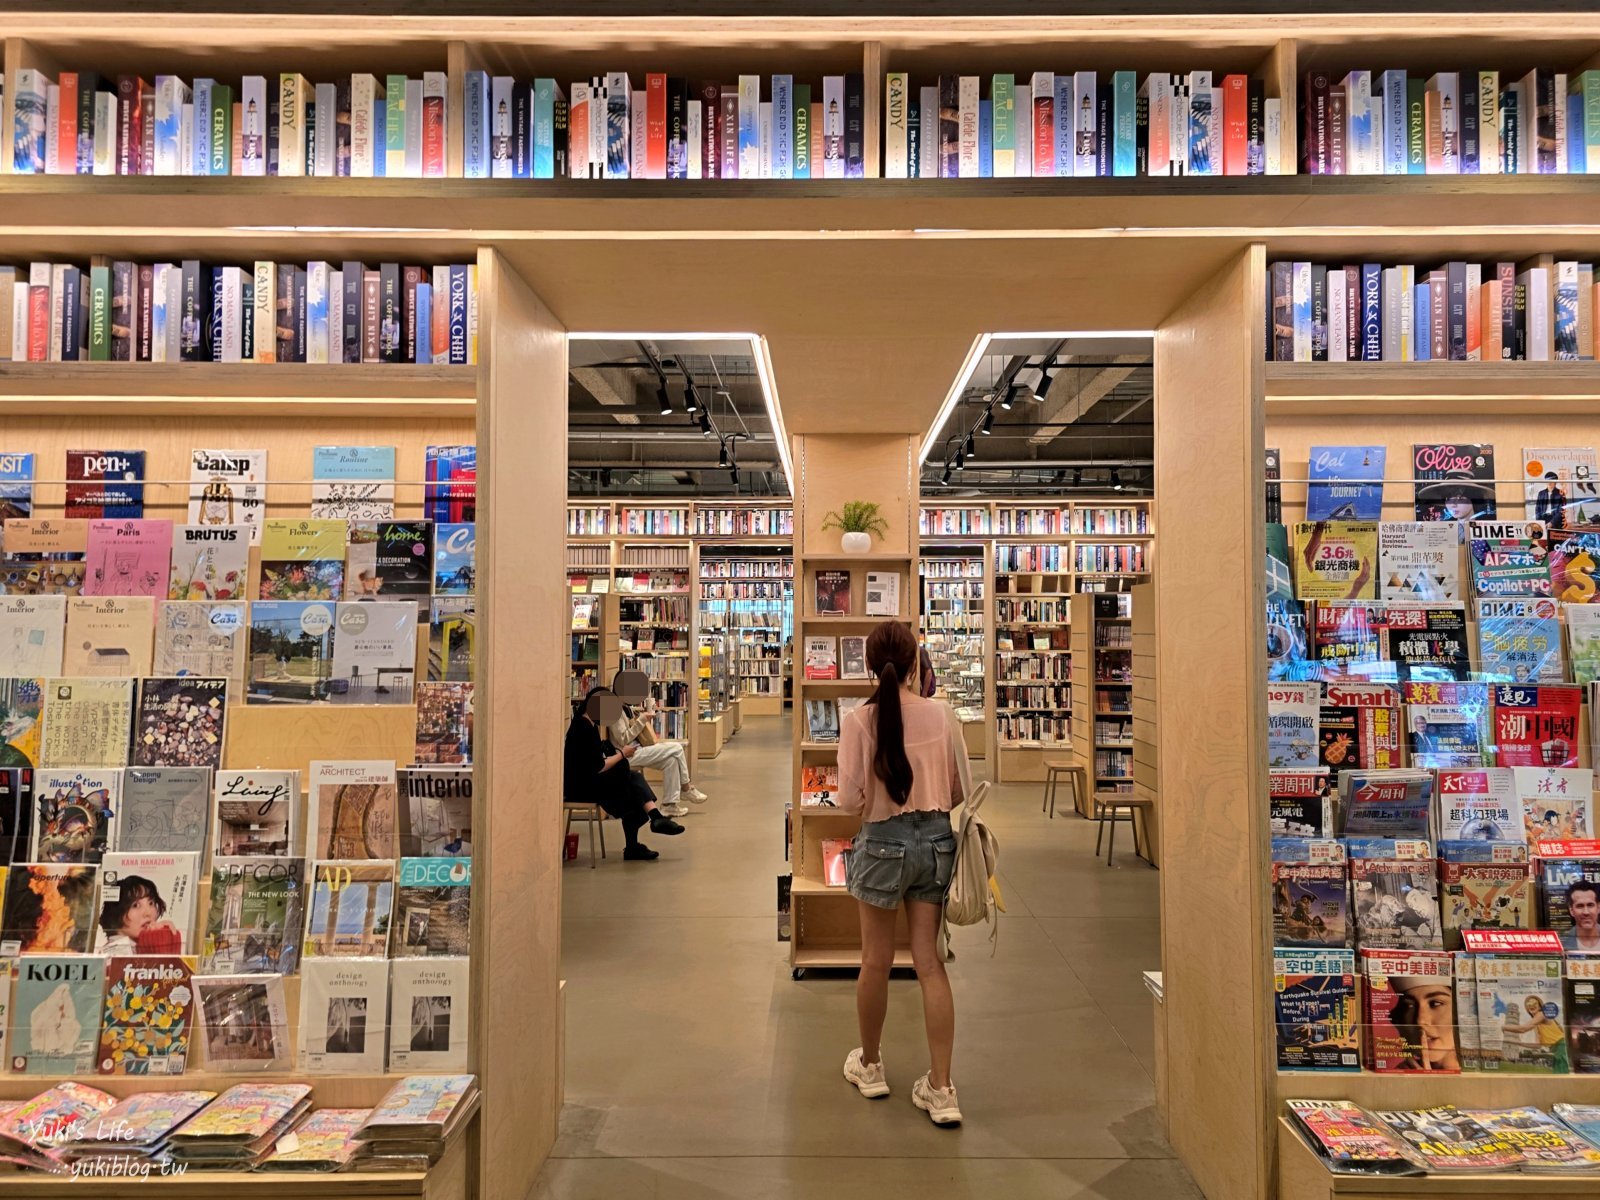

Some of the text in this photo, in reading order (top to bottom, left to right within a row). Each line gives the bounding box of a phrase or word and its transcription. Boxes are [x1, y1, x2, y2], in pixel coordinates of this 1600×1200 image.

[282, 77, 296, 130] CANDY
[890, 77, 904, 129] CANDY
[1481, 76, 1496, 127] CANDY
[387, 82, 399, 143] PEACHES
[995, 82, 1007, 143] PEACHES
[213, 107, 225, 170] CERAMICS
[726, 114, 734, 165] XIN LIFE
[796, 107, 807, 169] CERAMICS
[1333, 113, 1341, 163] XIN LIFE
[1411, 102, 1422, 164] CERAMICS
[256, 265, 270, 314] CANDY
[451, 272, 464, 308] YORK
[1314, 281, 1322, 296] THE
[1366, 271, 1379, 310] YORK
[1501, 266, 1513, 326] SUNSET
[93, 288, 104, 345] CERAMICS
[1434, 296, 1442, 342] XIN LIFE
[83, 455, 131, 477] pen+
[1315, 450, 1345, 473] Cal
[1415, 445, 1472, 471] Olive
[1330, 487, 1362, 498] JOURNEY
[31, 527, 59, 536] Interior
[116, 528, 140, 537] Paris
[185, 530, 238, 540] BRUTUS
[289, 528, 318, 537] Flowers
[1472, 525, 1515, 539] DIME
[1321, 546, 1354, 560] 3.6兆
[1554, 544, 1584, 554] CAN'T
[1314, 560, 1360, 571] 銀光商機
[1484, 553, 1535, 567] AIスマホ
[1531, 579, 1550, 592] PC
[7, 605, 35, 614] Interior
[95, 605, 124, 614] Interior
[1318, 607, 1356, 625] 財訊
[1482, 603, 1524, 616] DIME
[210, 612, 237, 625] Casa
[340, 613, 366, 624] Casa
[1389, 610, 1423, 626] 先探
[1506, 652, 1538, 662] 解消法
[196, 680, 224, 689] アイデア
[1327, 687, 1392, 707] Smart
[1498, 684, 1530, 706] 遠見
[1500, 714, 1575, 741] 潮中國
[132, 776, 157, 785] Design
[320, 768, 366, 777] ARCHITECT
[1357, 781, 1404, 801] 今周刊
[1443, 775, 1467, 791] 天下
[1450, 809, 1509, 821] 超科幻現場
[1539, 843, 1565, 856] 雜誌
[140, 858, 175, 867] HANAZAWA
[1368, 862, 1430, 874] Advanced
[316, 866, 351, 893] AD
[1463, 867, 1524, 882] 大家說英語
[26, 963, 96, 982] KOEL
[123, 964, 183, 981] frankie
[1286, 960, 1341, 974] 空中美語
[1381, 960, 1437, 976] 空中美語
[1280, 992, 1309, 1000] Earthquake
